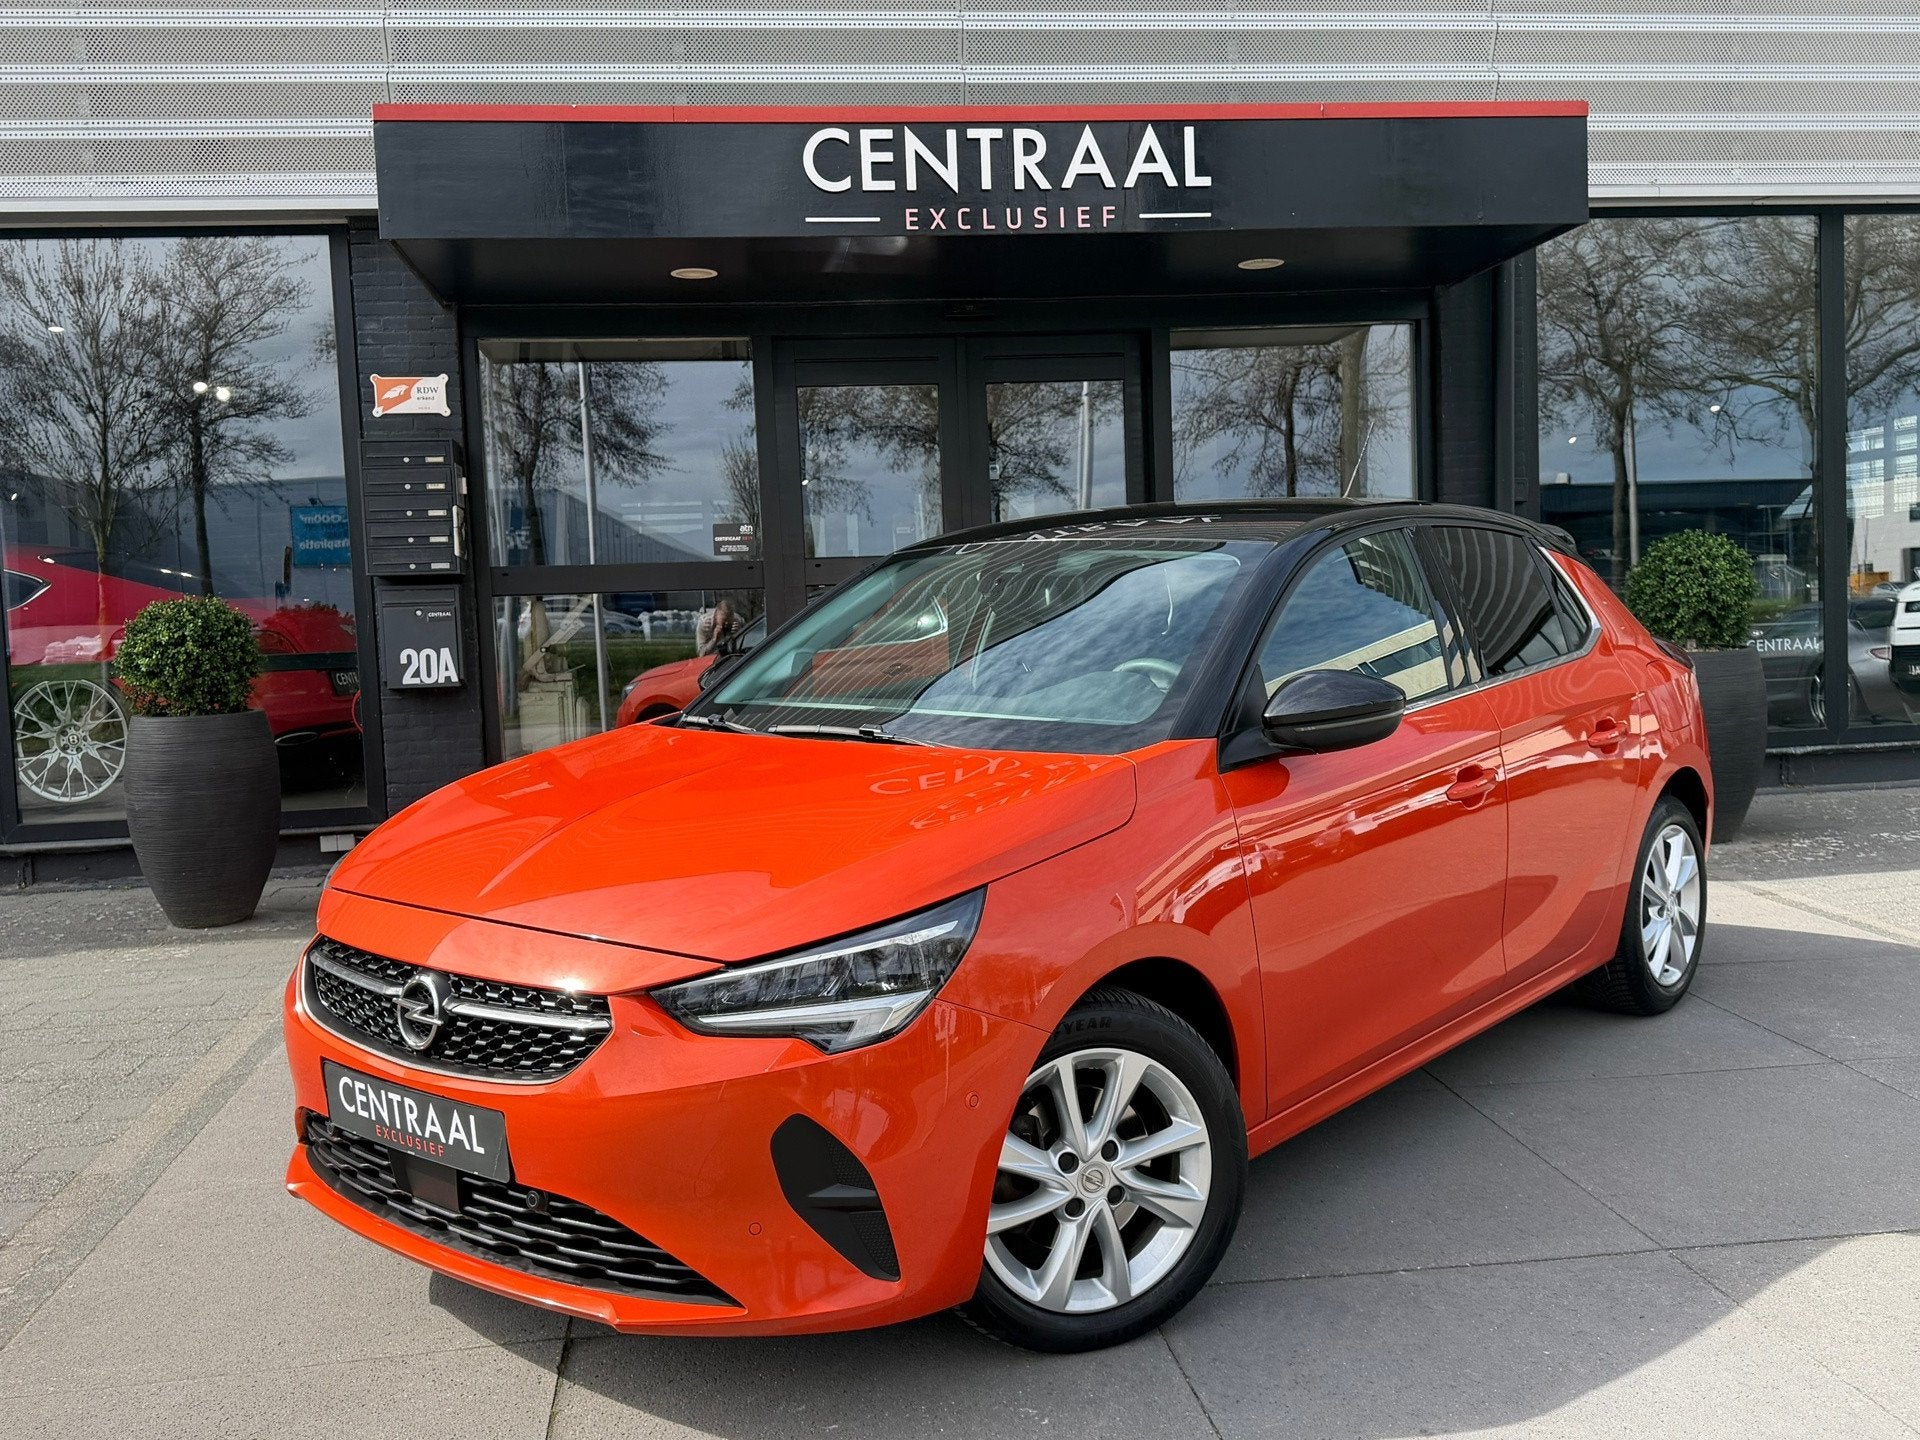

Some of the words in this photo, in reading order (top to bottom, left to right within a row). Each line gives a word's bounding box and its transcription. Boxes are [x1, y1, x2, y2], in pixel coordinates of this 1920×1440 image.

[803, 123, 1212, 194] CENTRAAL
[905, 206, 1116, 230] EXCLUSIEF
[416, 386, 439, 394] RDW
[740, 524, 753, 532] atn
[400, 647, 459, 685] 20A
[338, 1076, 485, 1154] CENTRAAL
[375, 1124, 445, 1157] EXCLUSIEF
